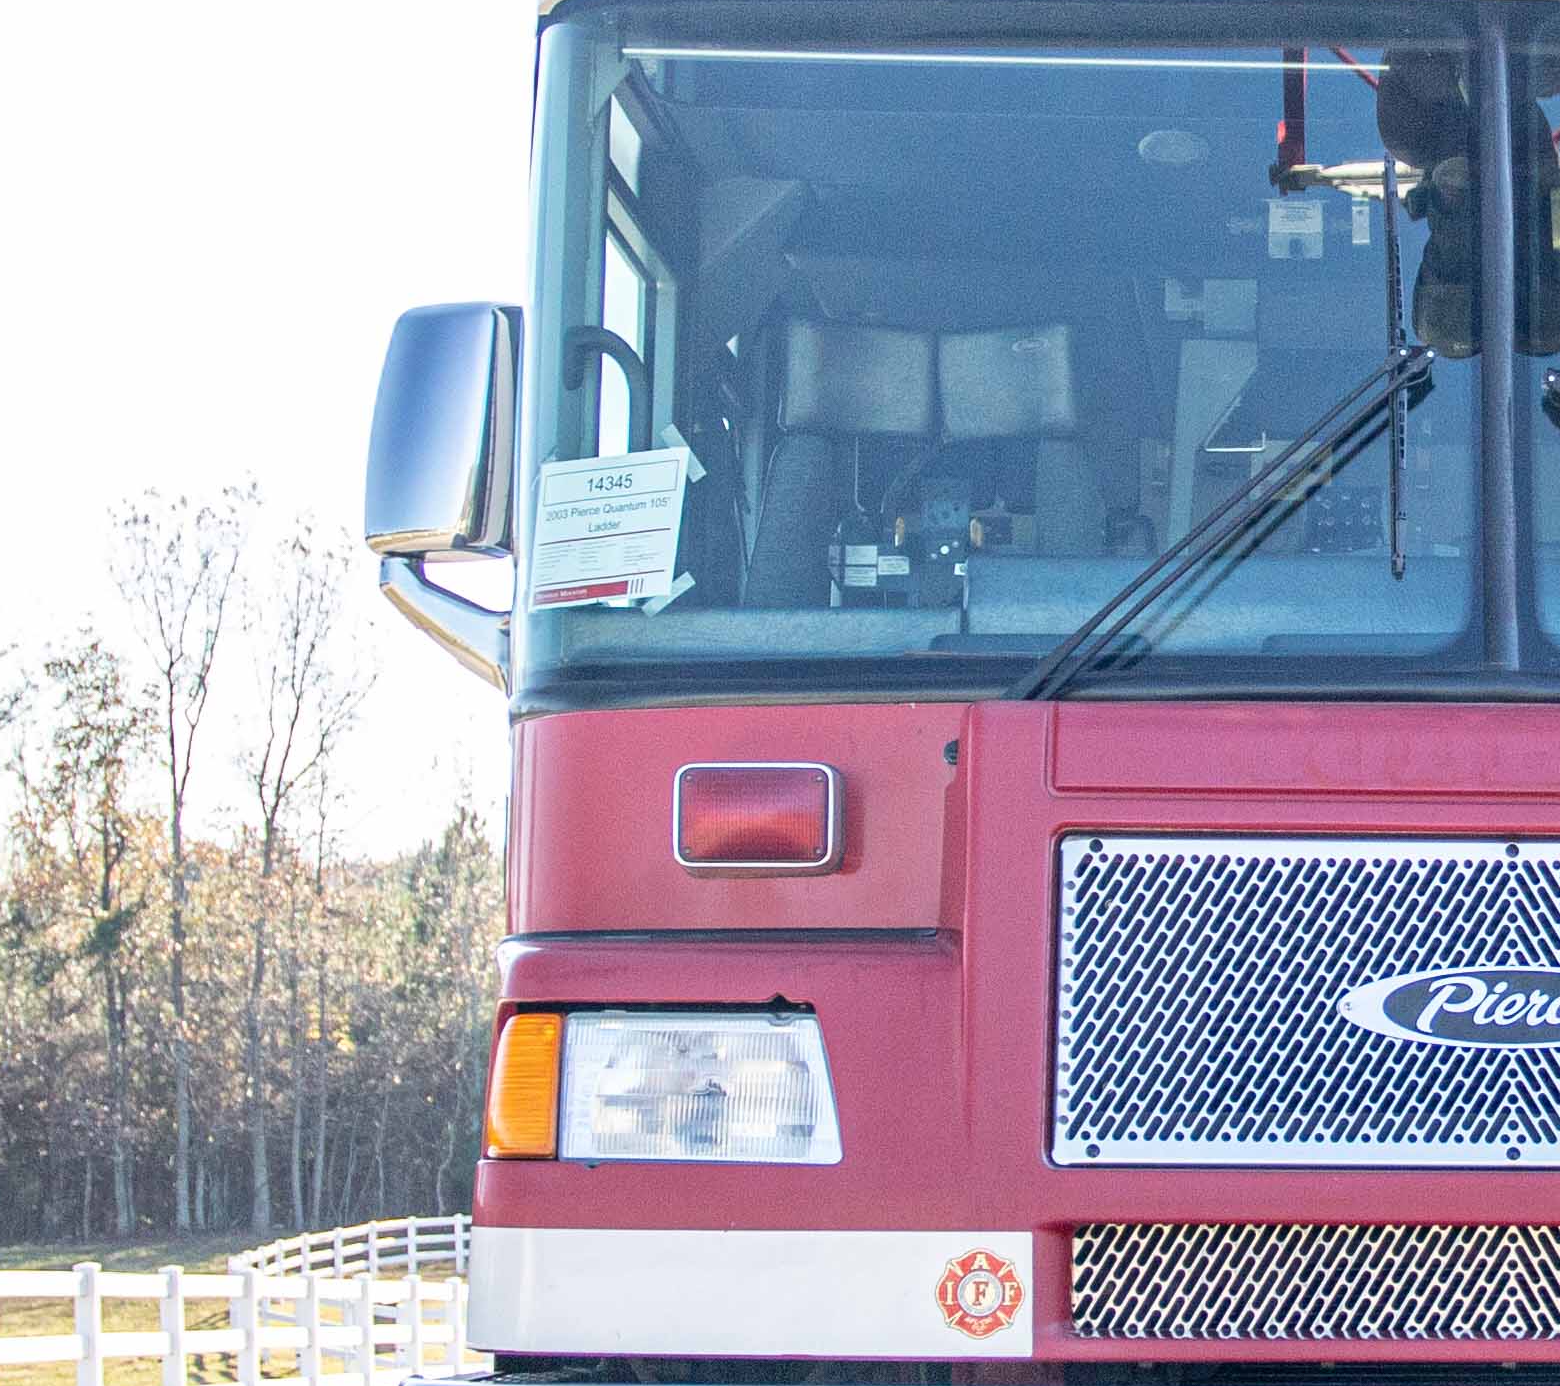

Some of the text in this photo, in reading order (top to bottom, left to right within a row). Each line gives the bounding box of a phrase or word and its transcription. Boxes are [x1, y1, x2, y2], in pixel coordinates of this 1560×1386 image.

[587, 473, 633, 492] 14345
[545, 509, 569, 522] 2003
[570, 506, 601, 518] Pierce
[603, 500, 647, 514] Quantum
[587, 521, 621, 533] Ladder
[971, 1253, 991, 1270] A
[972, 1281, 989, 1306] F
[1002, 1281, 1018, 1306] F
